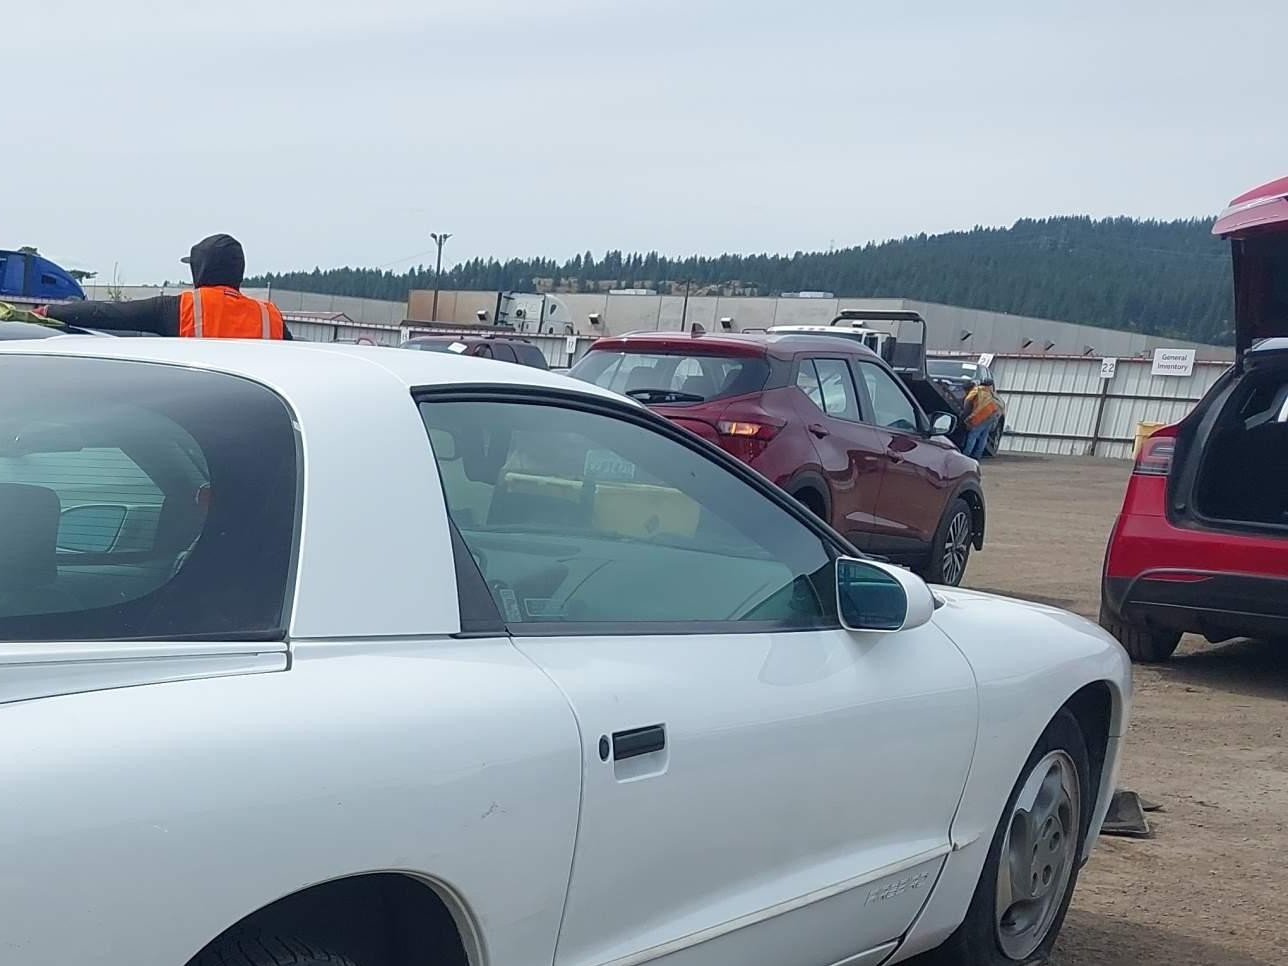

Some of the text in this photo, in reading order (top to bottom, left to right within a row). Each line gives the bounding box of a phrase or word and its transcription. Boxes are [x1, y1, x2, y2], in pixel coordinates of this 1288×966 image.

[1162, 353, 1188, 361] General
[1102, 363, 1115, 373] 22
[1157, 362, 1189, 371] Inventory
